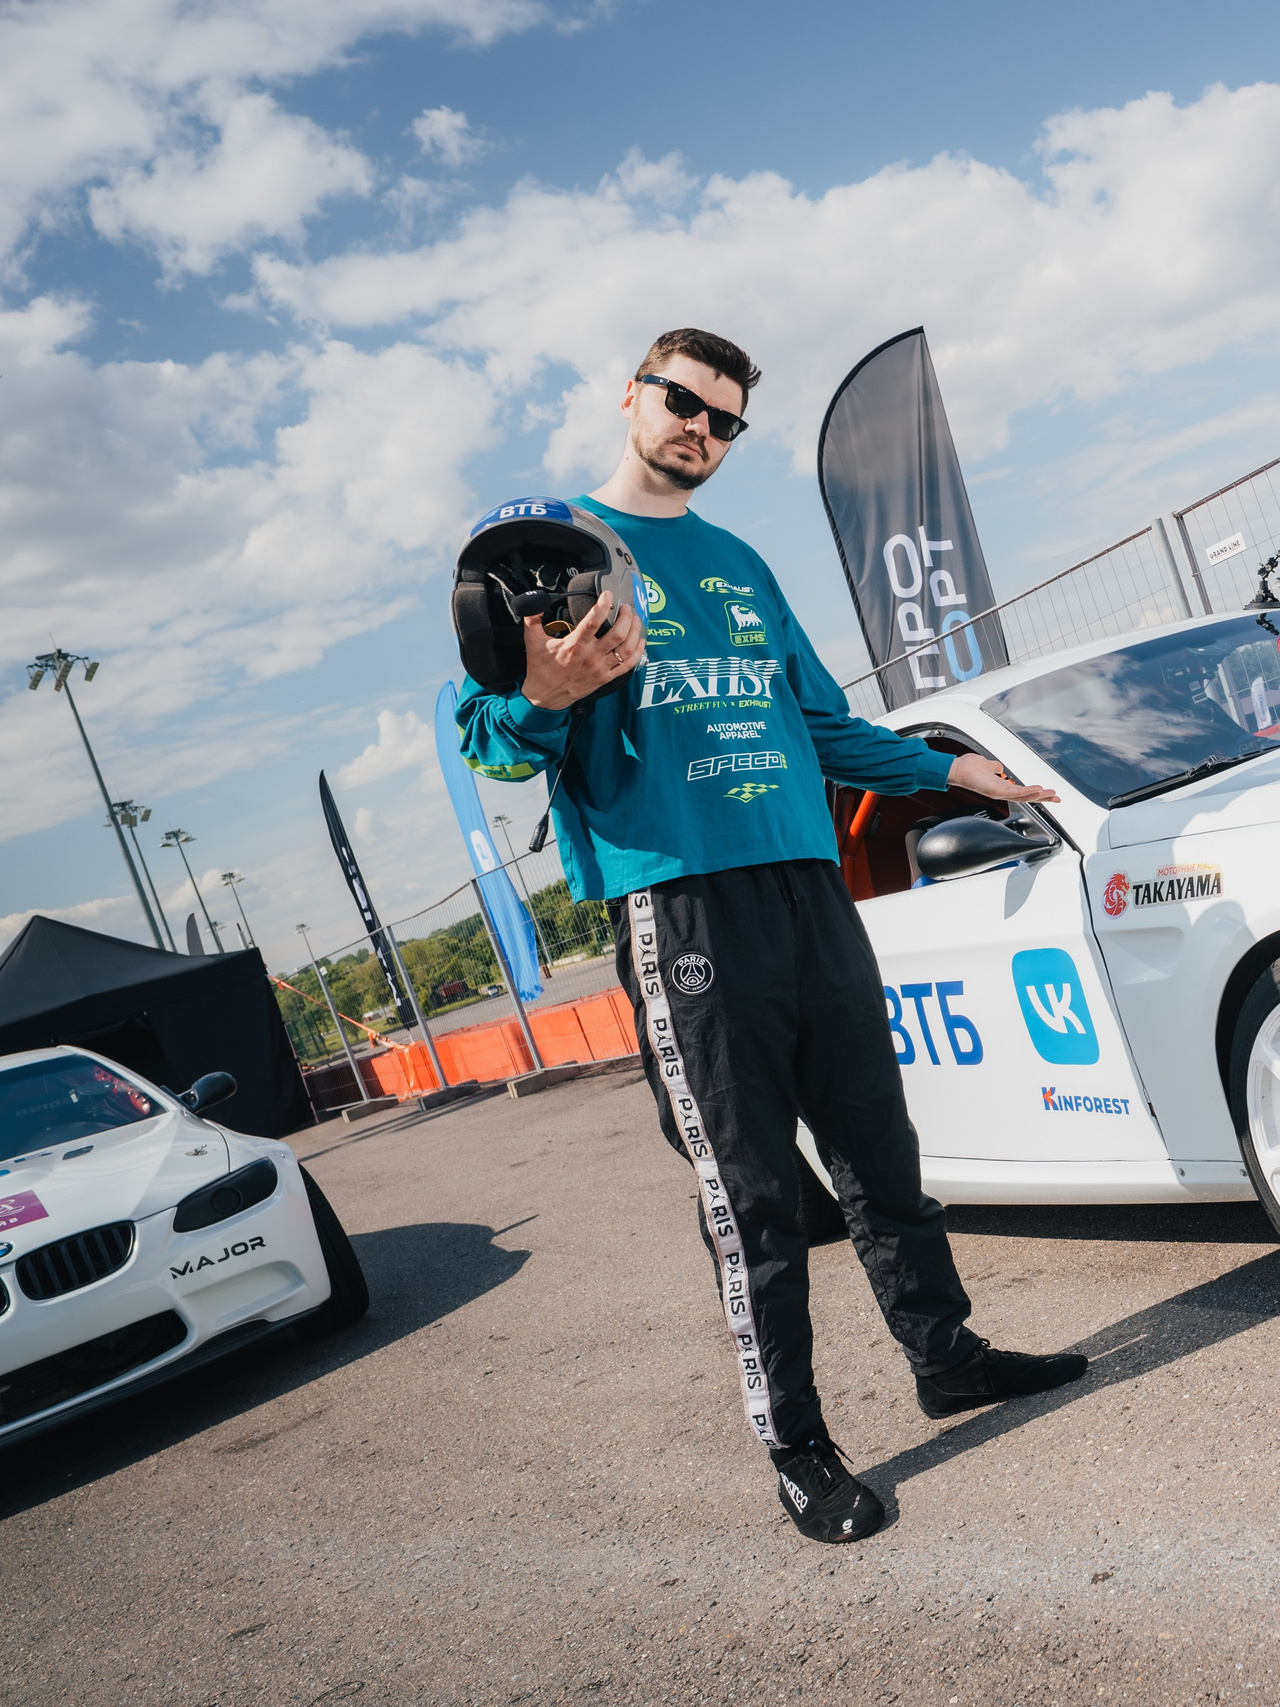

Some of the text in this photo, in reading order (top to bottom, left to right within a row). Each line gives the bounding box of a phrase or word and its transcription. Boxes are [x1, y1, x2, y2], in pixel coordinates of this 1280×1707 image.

[499, 503, 547, 519] ВТБ
[1209, 546, 1228, 559] GRAND
[918, 525, 983, 682] ОРТ
[647, 628, 677, 637] XHST
[673, 701, 712, 715] STREET
[738, 699, 772, 709] EXHAUST
[706, 721, 767, 734] AUTOMOTIVE
[720, 730, 762, 741] APPAREL
[687, 751, 783, 781] SPEED
[1157, 862, 1221, 877] МОТОРНЫЕ МАС
[1132, 872, 1222, 906] TAKAYAMA
[678, 956, 706, 967] PARIS
[1025, 982, 1087, 1035] VK
[882, 979, 984, 1066] ВТБ
[1041, 1086, 1130, 1116] KINFOREST
[169, 1236, 267, 1280] MAJOR
[752, 1413, 777, 1446] PAR
